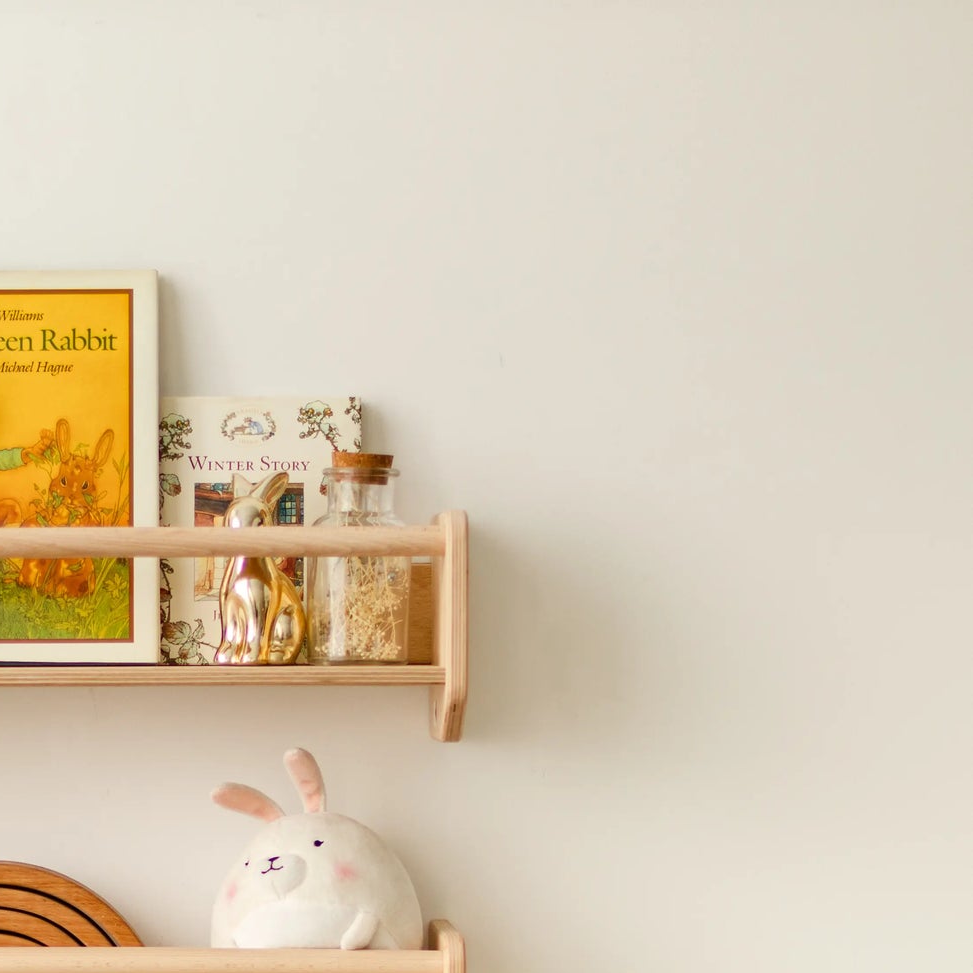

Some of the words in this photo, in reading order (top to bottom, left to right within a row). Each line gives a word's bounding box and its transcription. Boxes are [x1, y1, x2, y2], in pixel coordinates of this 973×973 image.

[41, 328, 117, 351] Rabbit
[36, 362, 73, 376] Hague
[188, 456, 254, 471] WINTER
[260, 456, 310, 471] STORY
